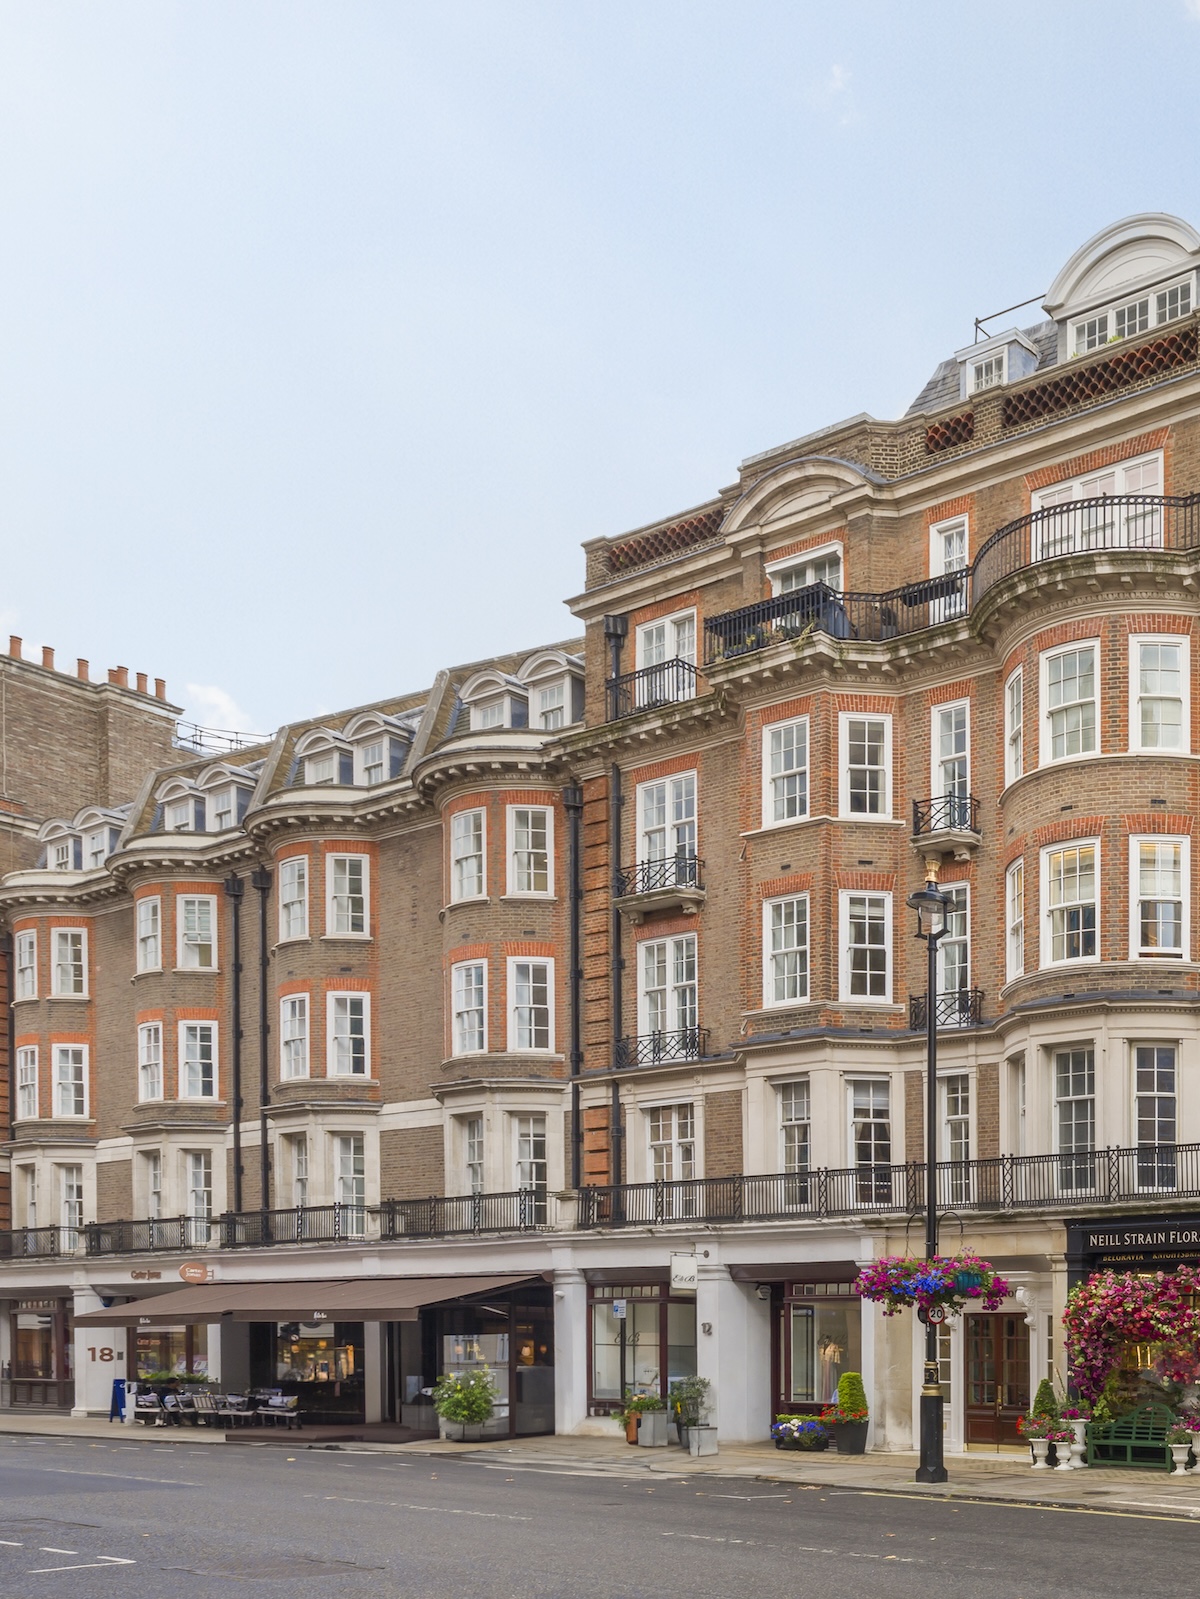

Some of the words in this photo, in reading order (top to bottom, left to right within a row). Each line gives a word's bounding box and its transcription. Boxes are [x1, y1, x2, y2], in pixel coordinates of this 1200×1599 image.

[1089, 1234, 1121, 1246] NEILL
[1123, 1232, 1166, 1245] STRAIN
[930, 1309, 943, 1319] 20
[87, 1346, 115, 1363] 18
